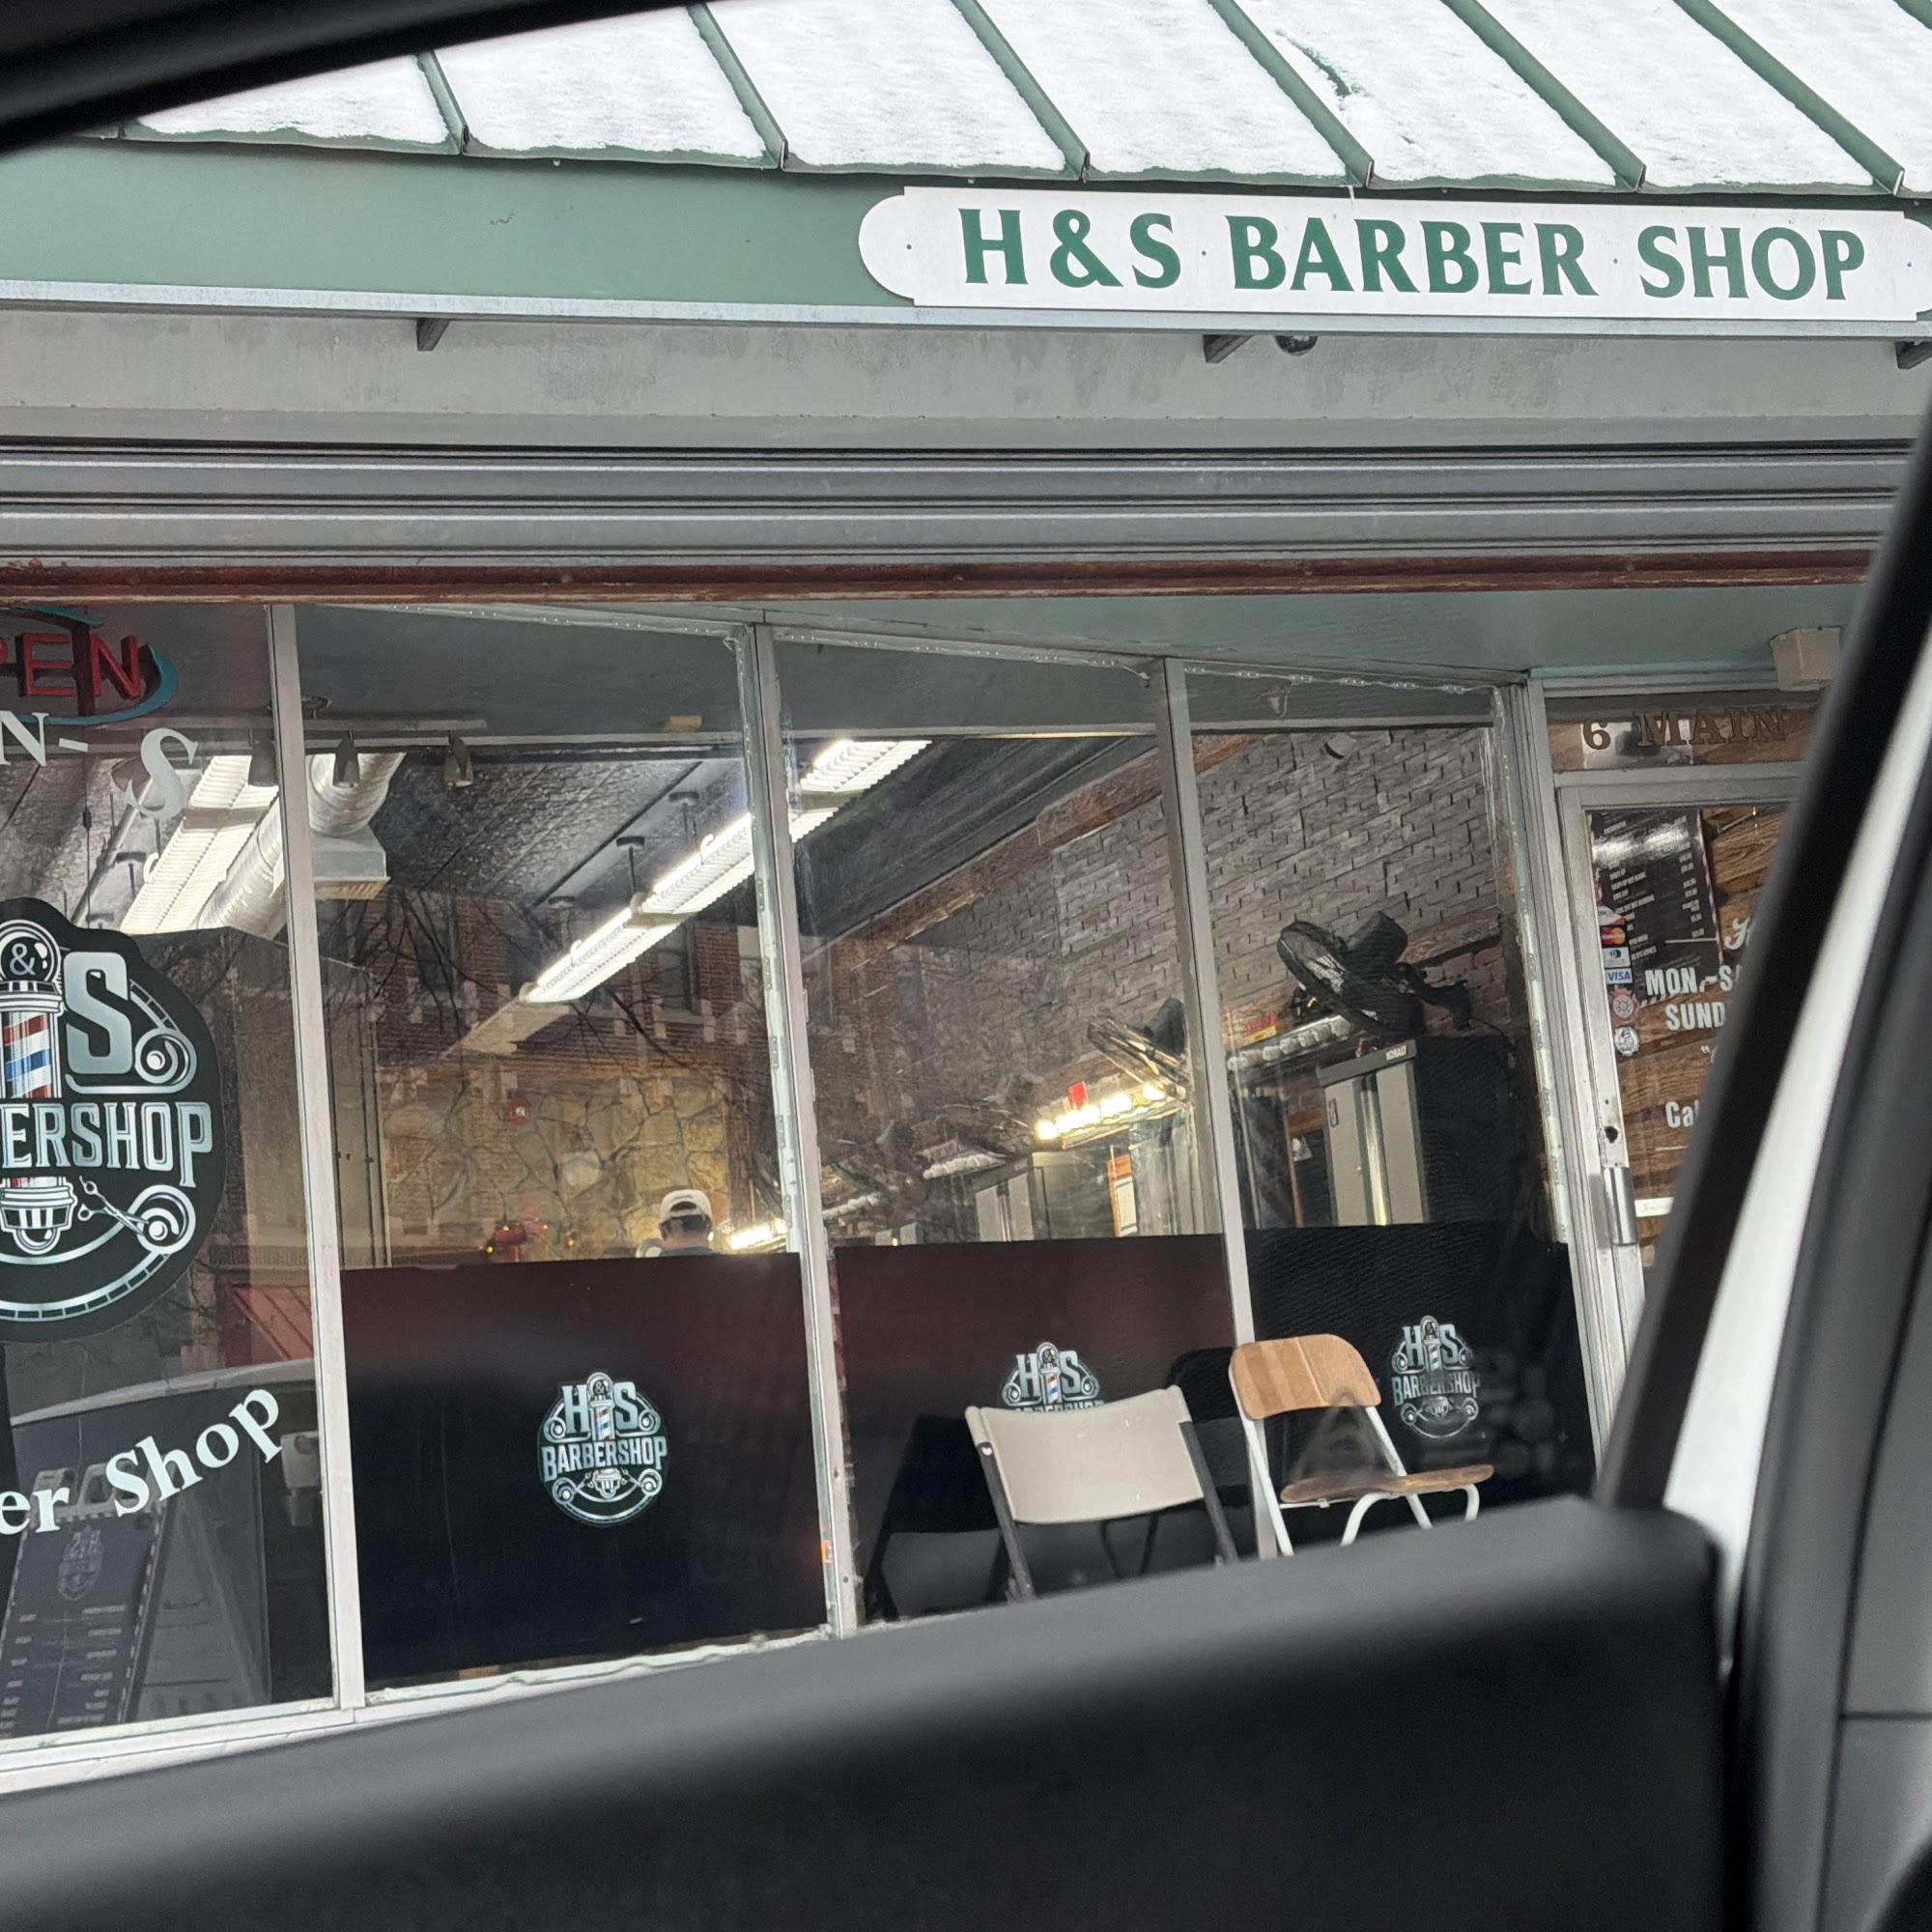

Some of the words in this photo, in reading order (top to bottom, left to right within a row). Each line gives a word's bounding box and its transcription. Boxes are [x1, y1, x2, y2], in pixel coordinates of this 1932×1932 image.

[1227, 214, 1598, 297] BARBER
[1638, 226, 1865, 300] SHOP
[1635, 706, 1787, 747] MAIN
[124, 728, 198, 820] S
[1607, 971, 1631, 981] VISA
[1664, 1002, 1726, 1031] SUND
[0, 1101, 213, 1187] ERSHOP
[0, 1486, 71, 1535] er
[106, 1389, 282, 1517] Shop
[541, 1436, 668, 1483] BARBERSHOP
